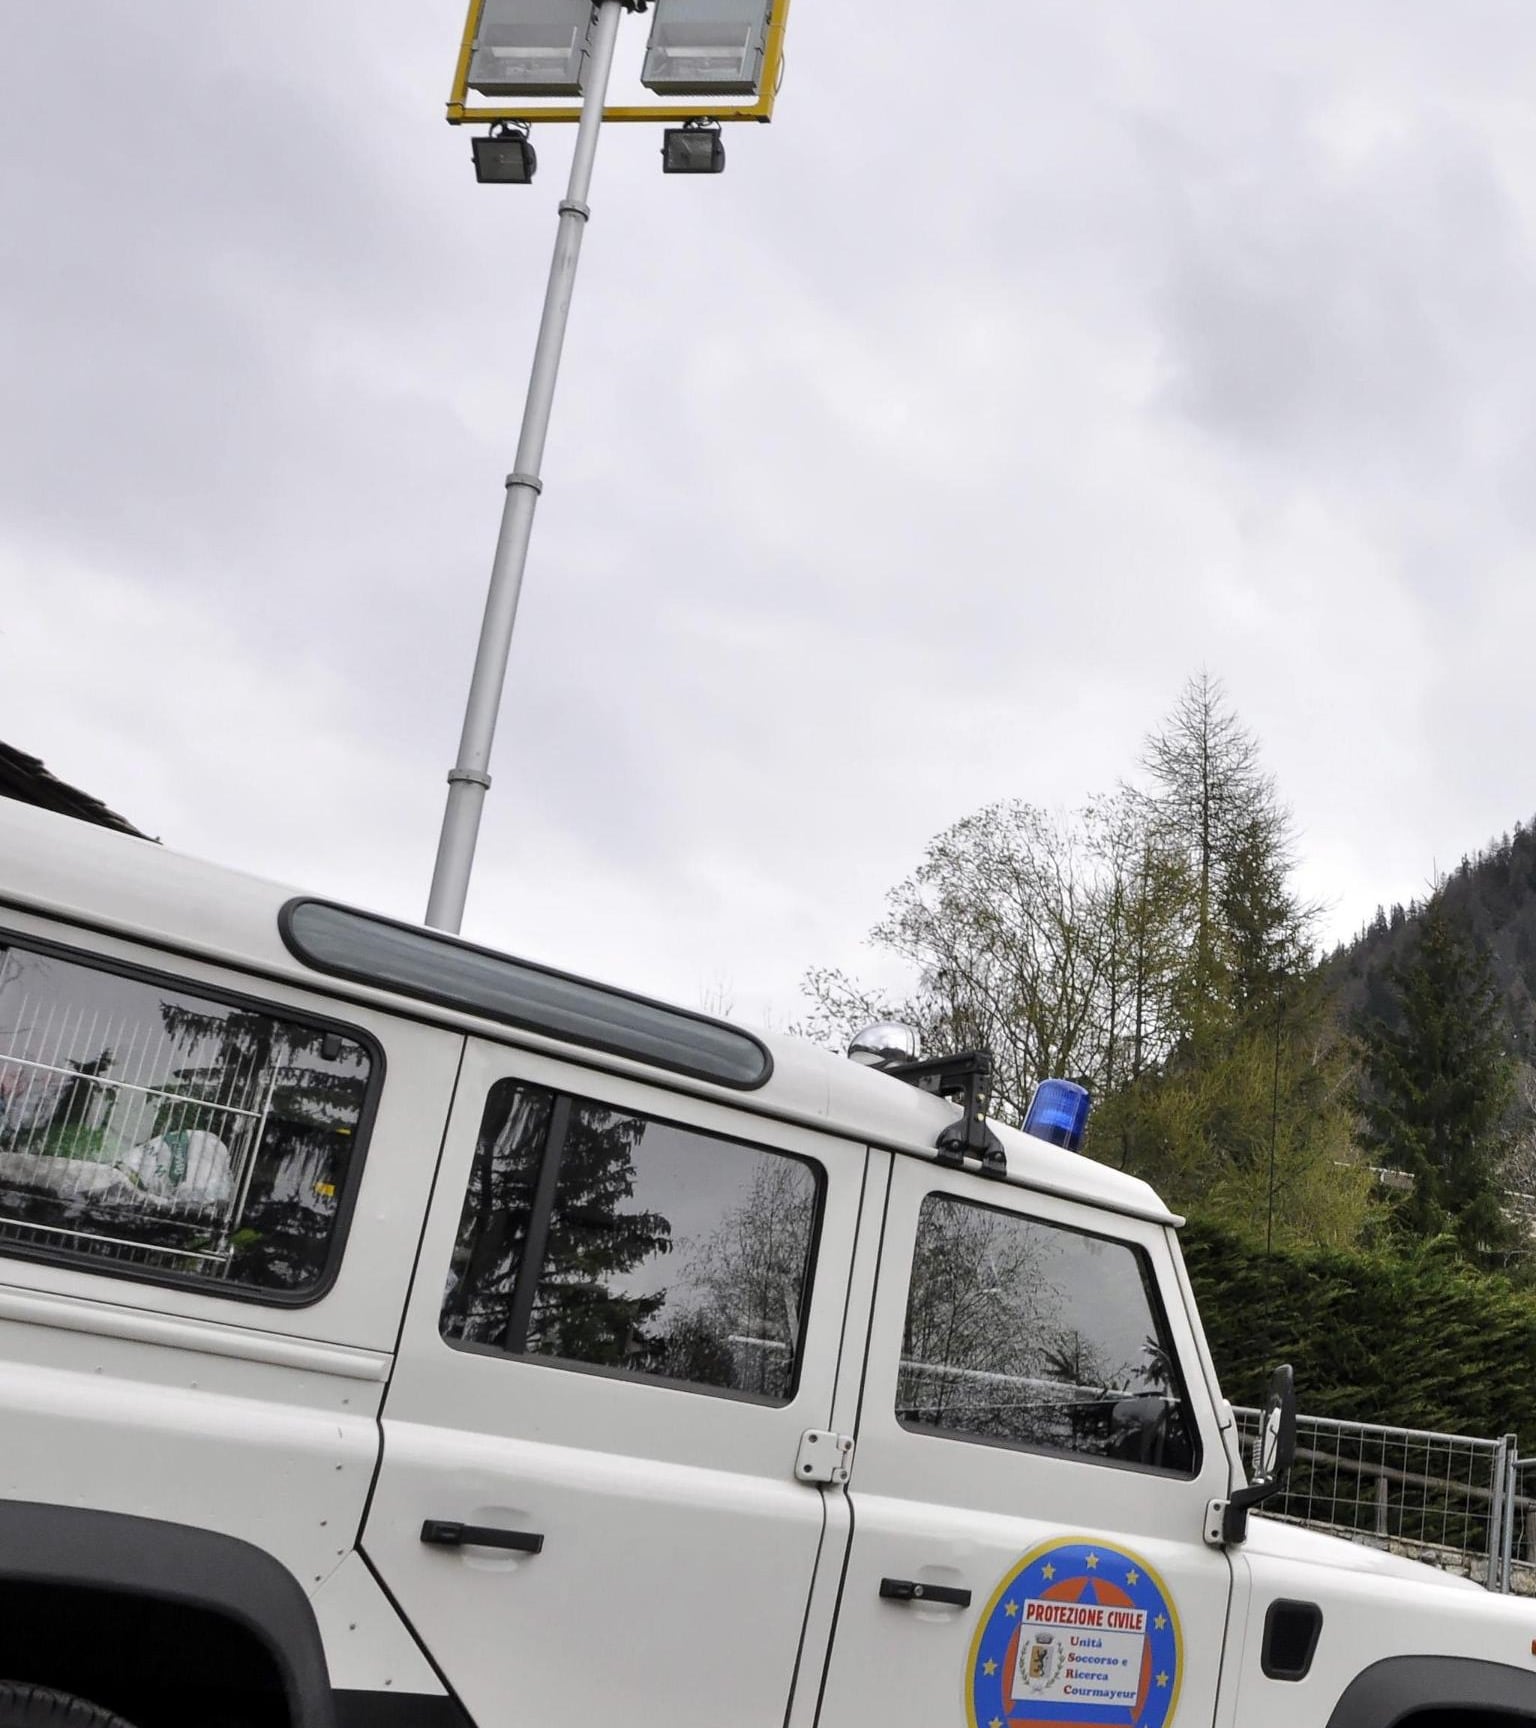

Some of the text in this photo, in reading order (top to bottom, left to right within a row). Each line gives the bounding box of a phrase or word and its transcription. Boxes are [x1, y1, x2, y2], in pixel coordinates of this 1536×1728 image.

[1026, 1603, 1143, 1630] PROTEZIONE CIVILE
[1067, 1652, 1128, 1667] Soccorso e
[1065, 1668, 1109, 1681] Ricerca
[1063, 1684, 1137, 1699] Courmayeur
